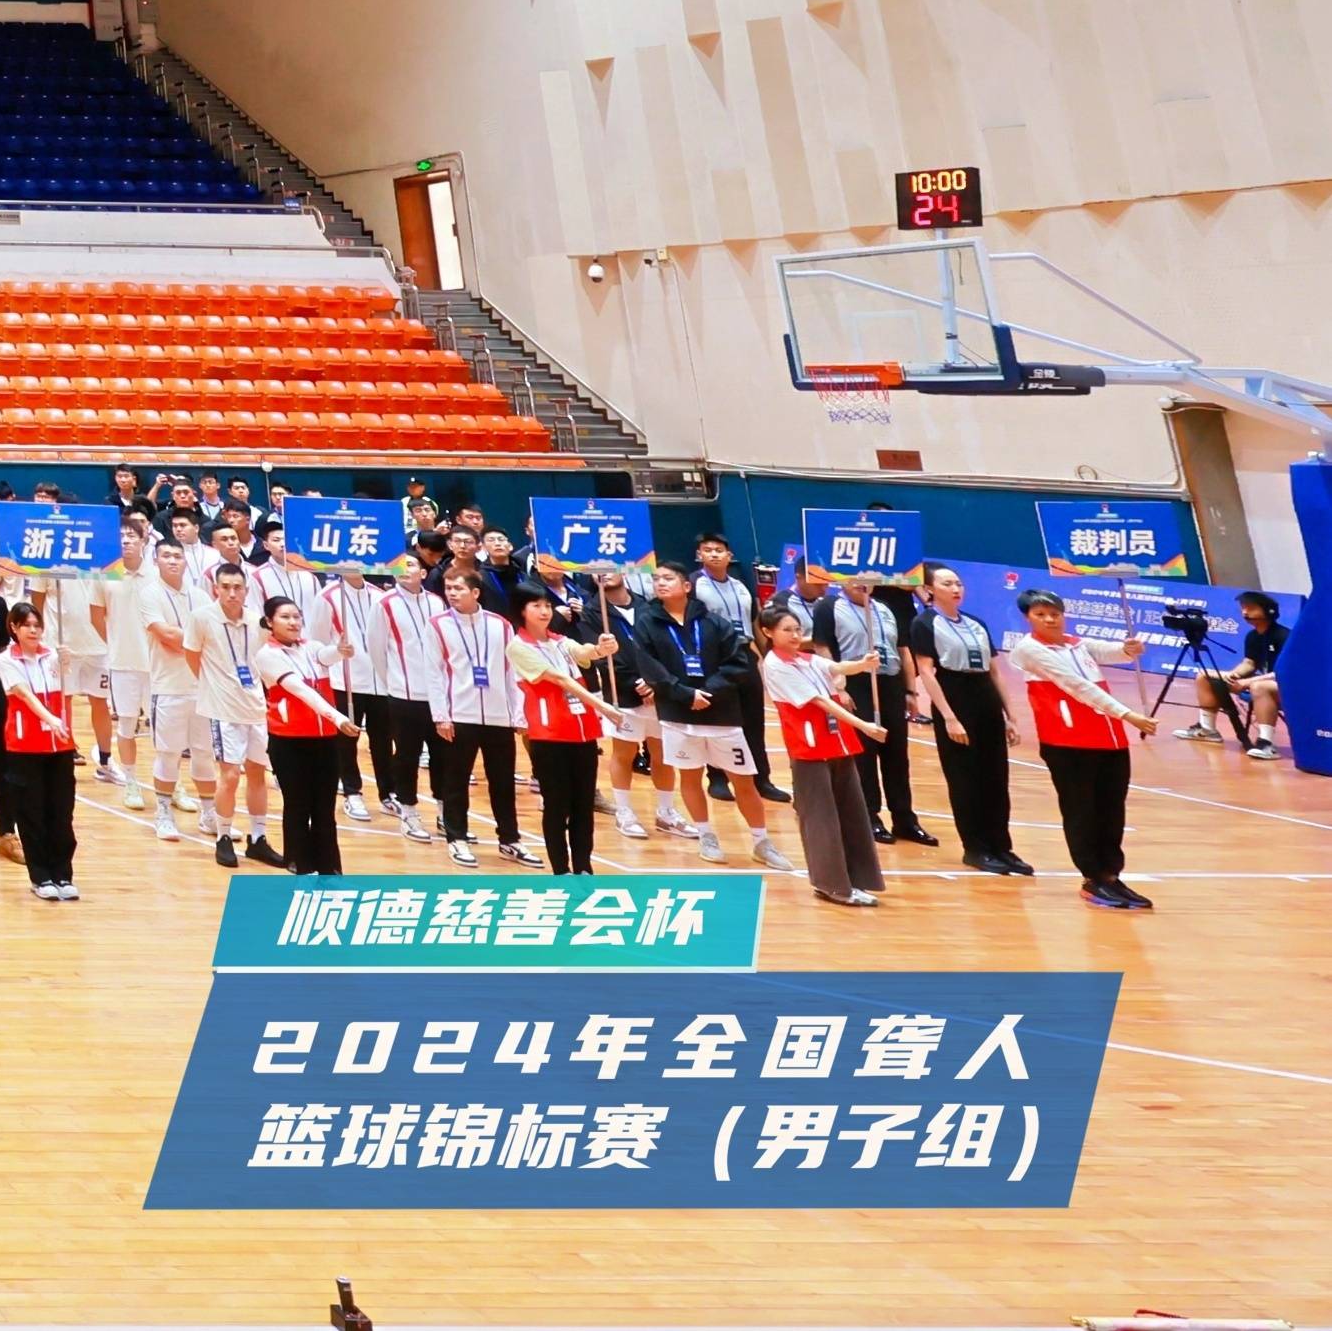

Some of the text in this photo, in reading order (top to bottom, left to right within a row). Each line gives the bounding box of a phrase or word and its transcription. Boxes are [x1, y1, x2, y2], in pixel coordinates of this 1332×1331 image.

[911, 169, 967, 194] 10:00
[913, 194, 959, 226] 24
[21, 527, 95, 561] 浙江
[310, 524, 380, 557] 山东
[560, 522, 628, 555] 广东
[830, 536, 897, 567] 四川
[1069, 528, 1157, 557] 裁判员
[731, 747, 746, 766] 3
